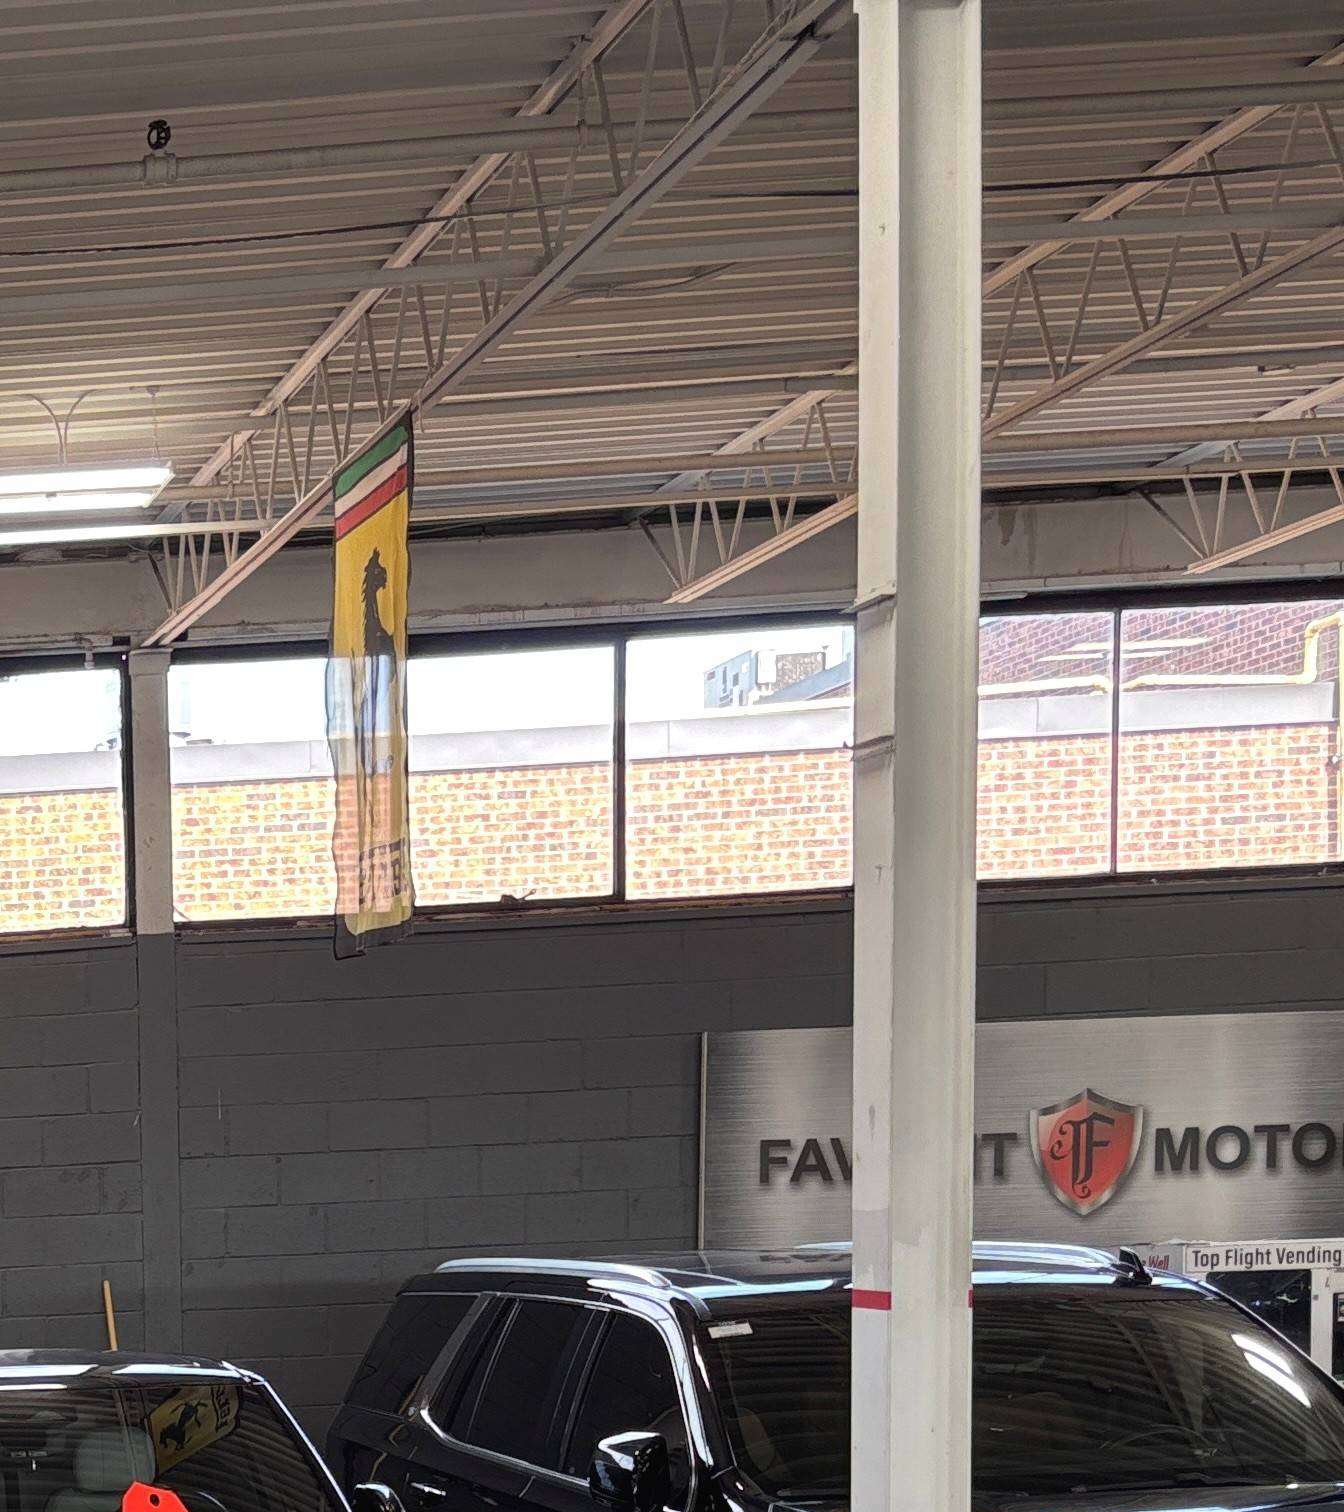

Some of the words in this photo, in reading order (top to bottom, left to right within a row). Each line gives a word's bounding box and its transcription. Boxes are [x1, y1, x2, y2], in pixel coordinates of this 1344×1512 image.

[760, 1131, 1017, 1184] FAVT
[1154, 1122, 1344, 1172] MOTO
[1192, 1250, 1220, 1270] Top
[1225, 1247, 1272, 1269] Flight
[1275, 1246, 1342, 1267] Vending
